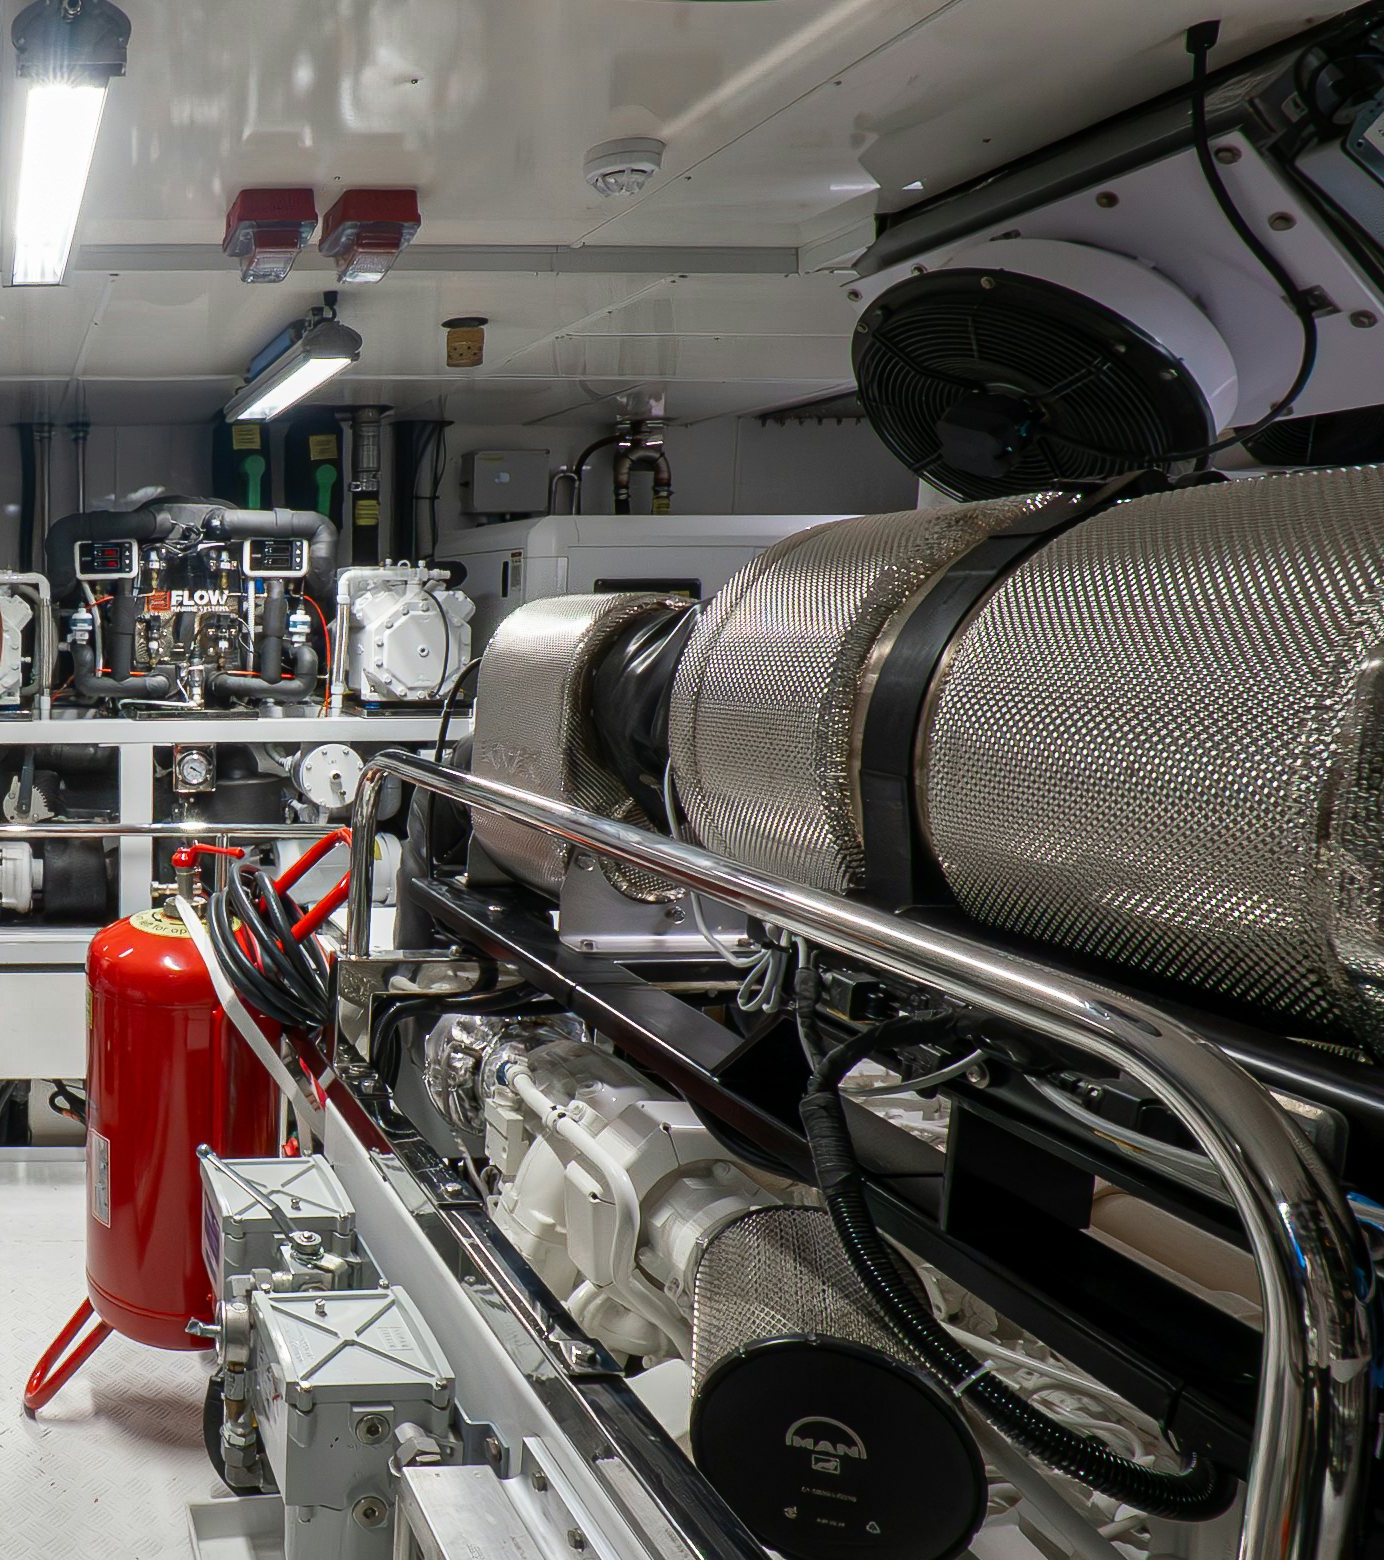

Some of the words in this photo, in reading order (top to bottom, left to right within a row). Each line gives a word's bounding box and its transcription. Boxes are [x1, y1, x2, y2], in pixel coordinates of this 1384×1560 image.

[171, 589, 230, 606] FLOW
[152, 924, 168, 932] for
[792, 1435, 860, 1458] MAN
